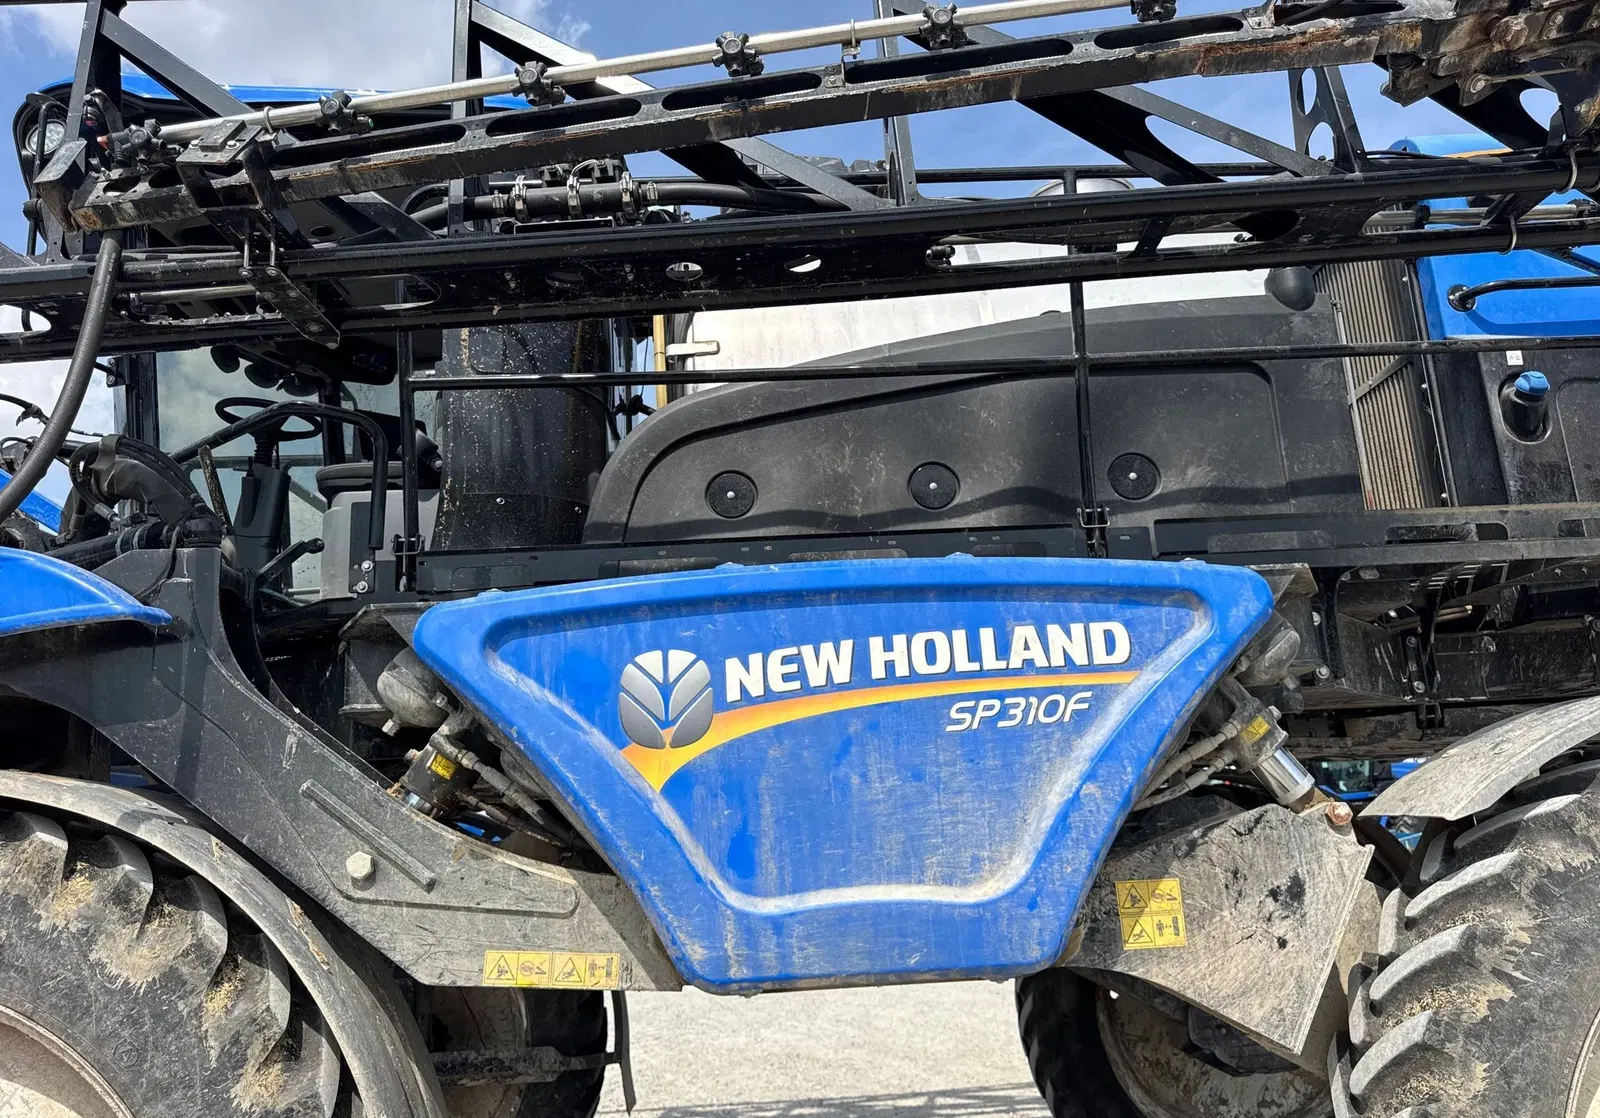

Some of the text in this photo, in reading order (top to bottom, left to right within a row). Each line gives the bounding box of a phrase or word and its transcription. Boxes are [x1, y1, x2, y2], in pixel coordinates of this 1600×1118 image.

[725, 621, 1132, 703] NEW HOLLAND
[945, 691, 1093, 732] SP310F
